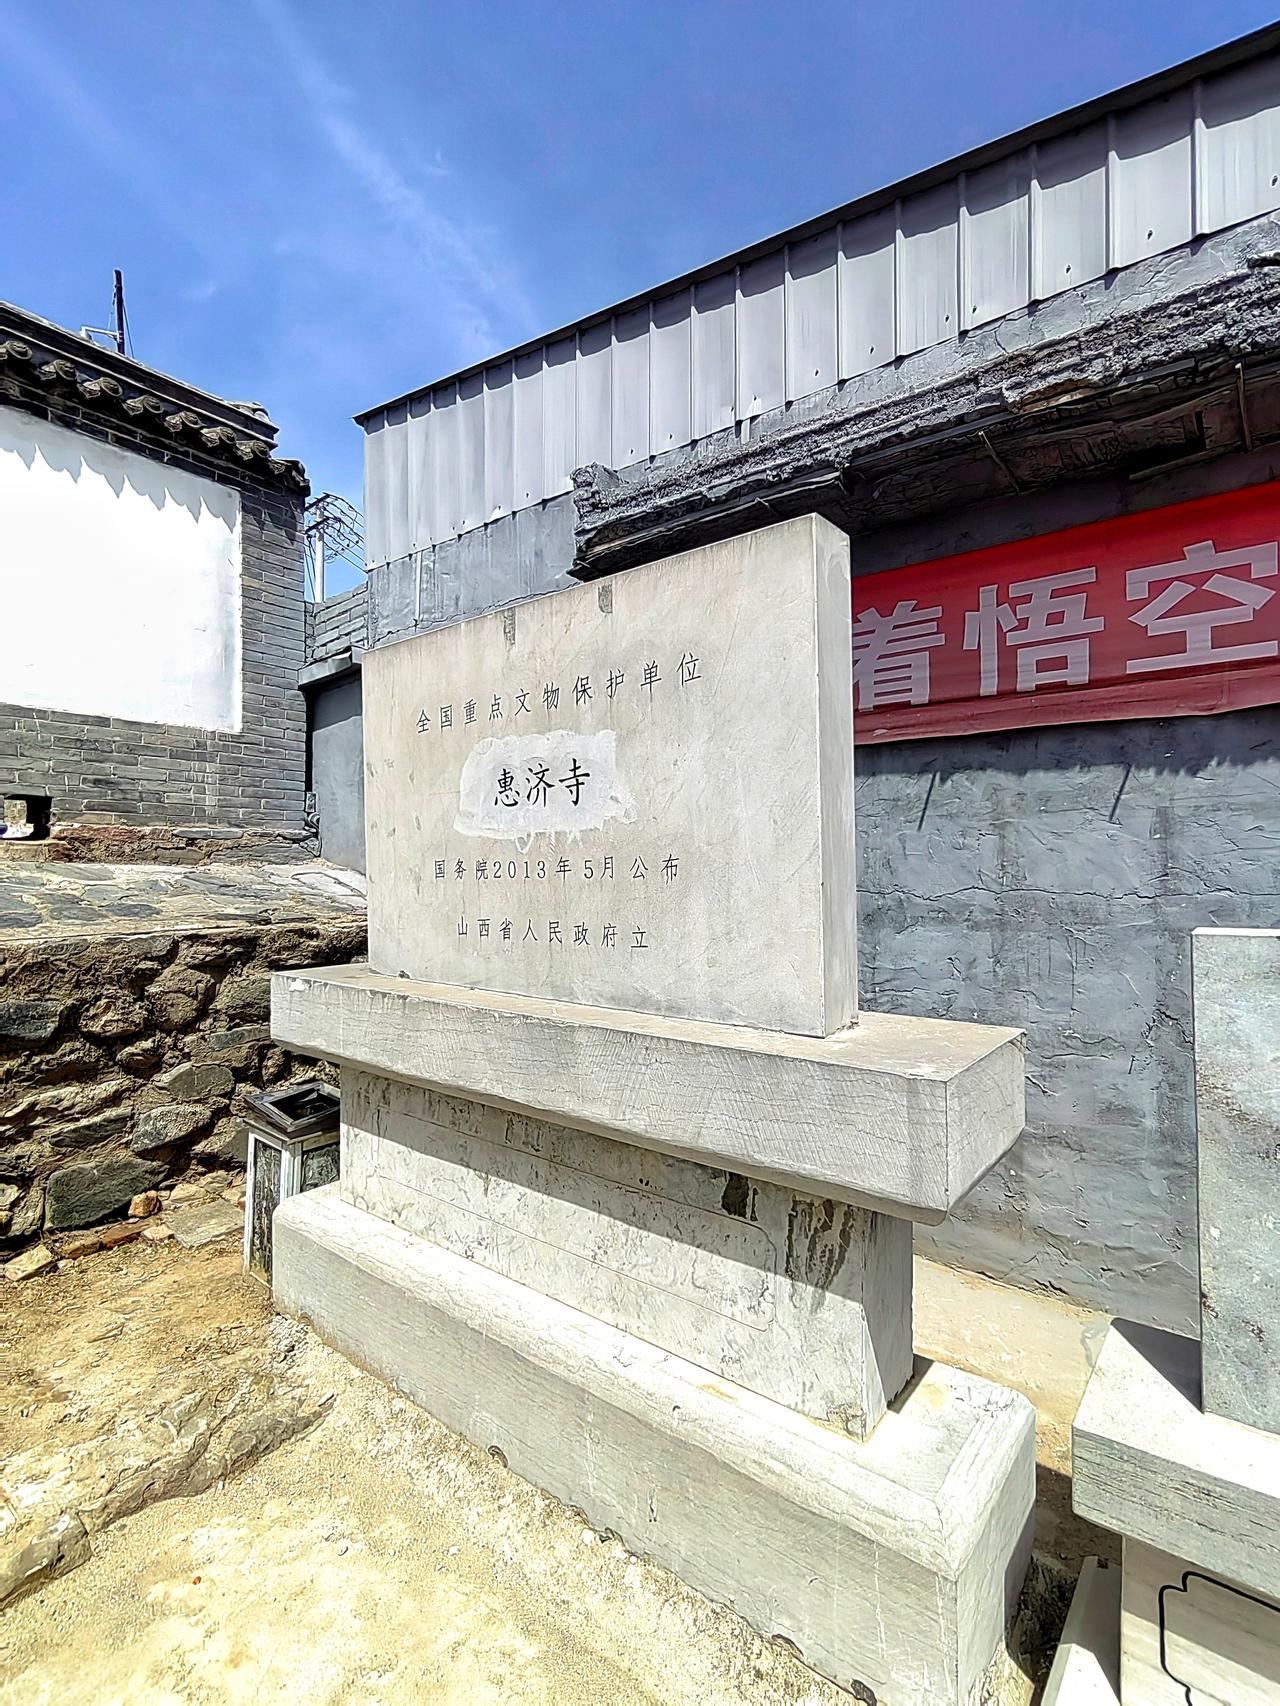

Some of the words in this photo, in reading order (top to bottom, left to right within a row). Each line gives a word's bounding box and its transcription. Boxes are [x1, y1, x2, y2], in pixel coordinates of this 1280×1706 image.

[852, 540, 1279, 712] 着悟空
[416, 652, 702, 734] 全国重点文物保护单位
[494, 758, 591, 807] 惠济寺
[434, 854, 680, 884] 国务院2013年5月公布
[457, 916, 649, 949] 山西省人民政府立
